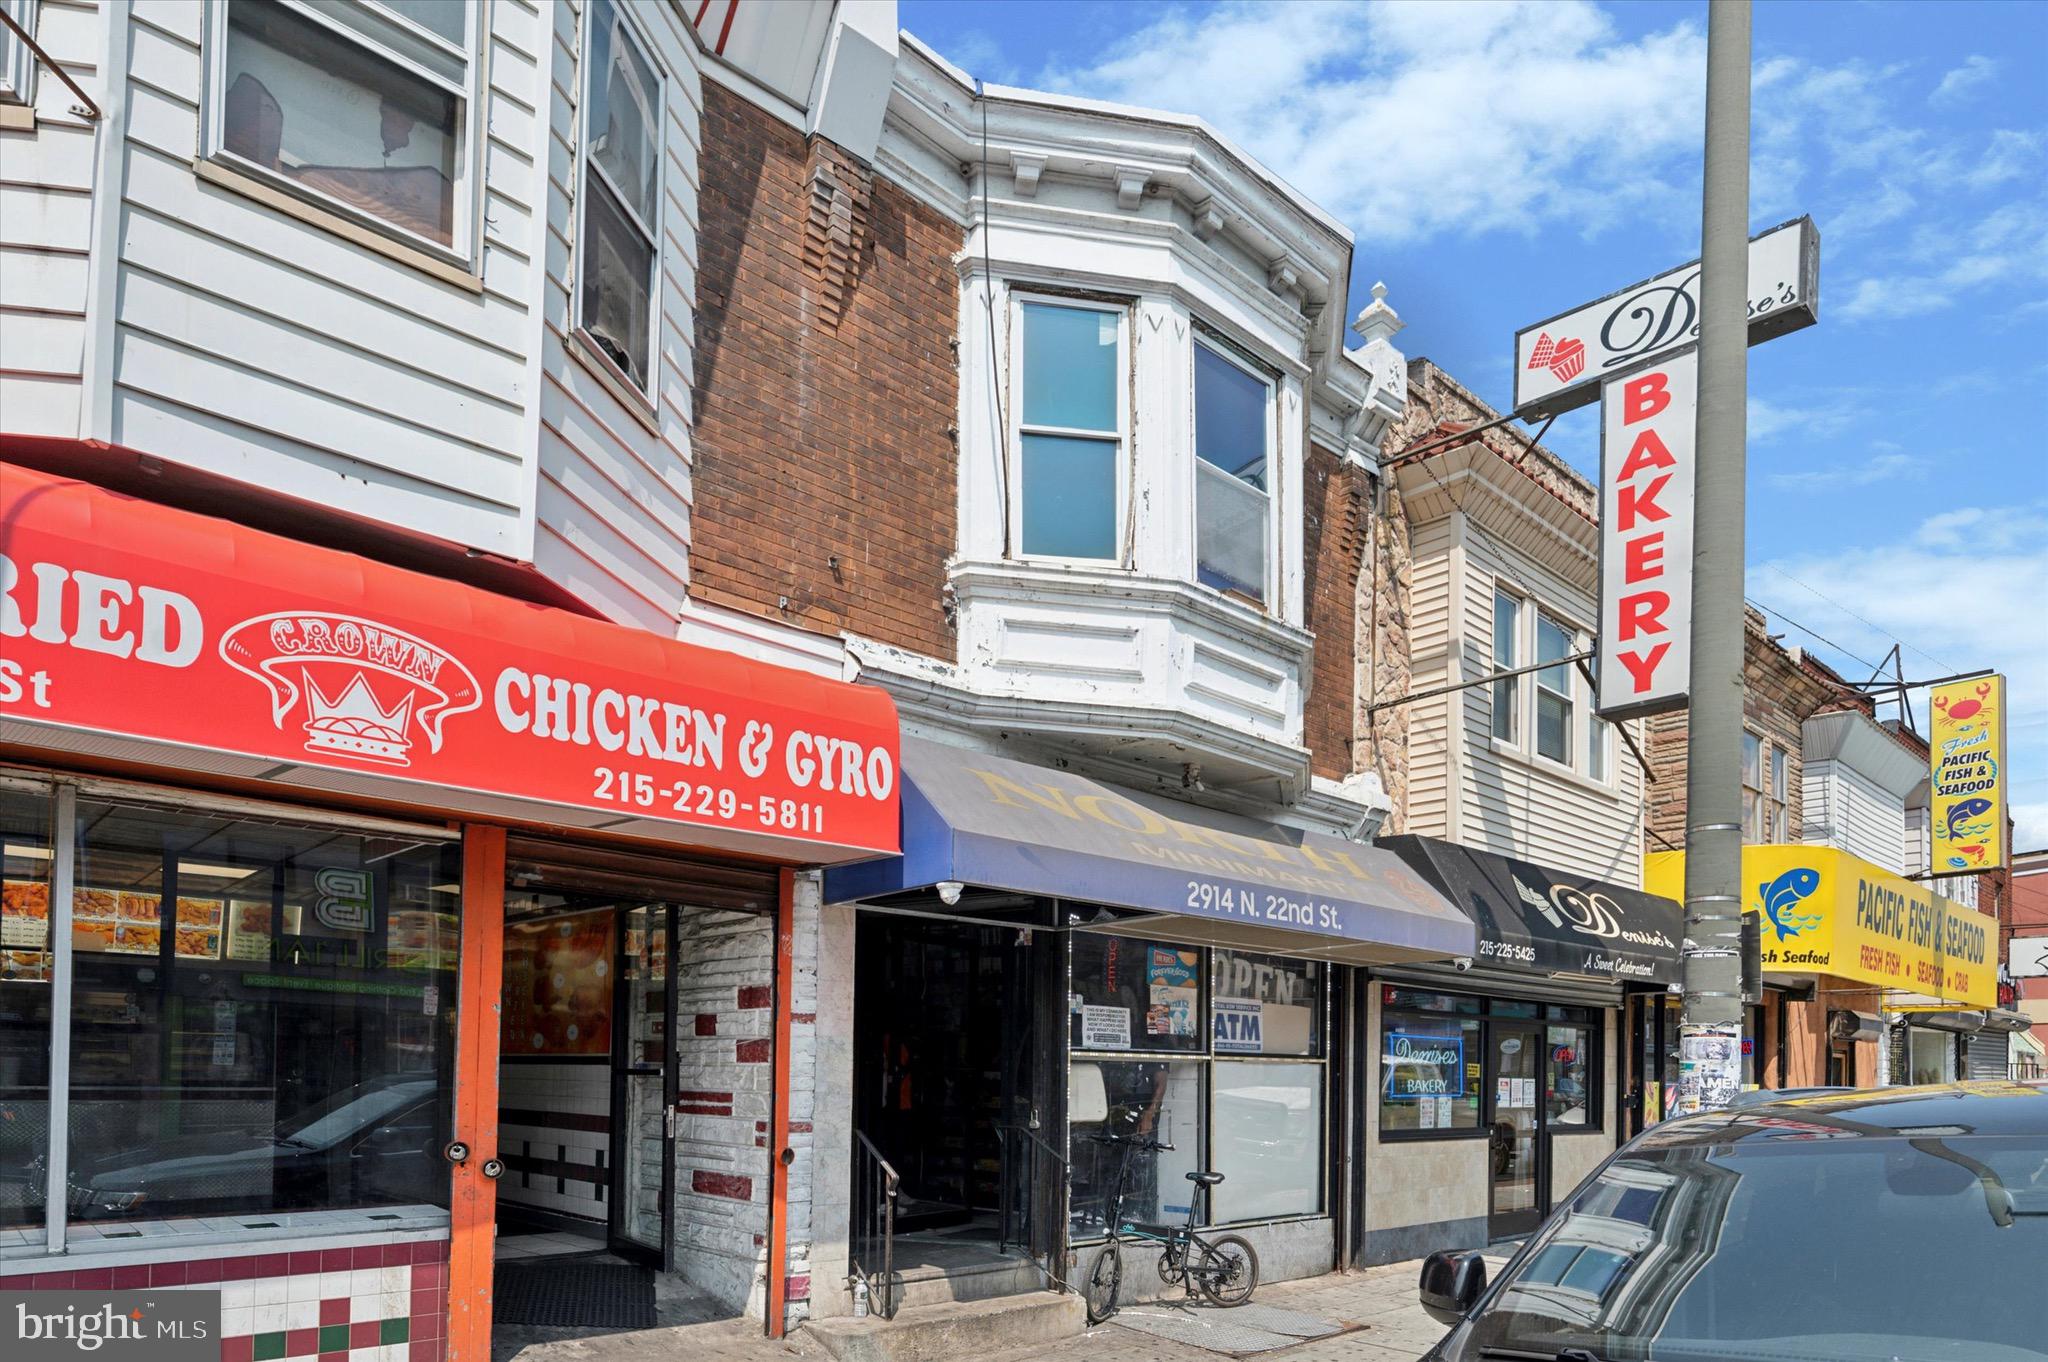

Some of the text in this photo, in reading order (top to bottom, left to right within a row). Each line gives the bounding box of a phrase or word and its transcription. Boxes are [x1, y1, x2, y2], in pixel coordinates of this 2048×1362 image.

[1601, 271, 1796, 368] Dese's
[1616, 372, 1677, 694] BAKERY
[270, 618, 447, 684] CROWN
[0, 658, 52, 708] St
[494, 667, 893, 800] CHICKEN & GYRO
[1942, 729, 1988, 756] Fresh
[1942, 750, 1990, 767] PACIFIC
[1944, 765, 1987, 781] FISH &
[593, 767, 823, 833] 215-229-5811
[1937, 778, 1995, 797] SEAFOOD
[1187, 881, 1342, 930] 2914 N. 22nd St.
[1856, 877, 1985, 965] PACIFIC FISH & SEAFOOD
[1107, 940, 1118, 992] OPEN
[1480, 939, 1536, 961] 215-225-5425
[1584, 953, 1655, 977] A Sweet Celebration!
[1782, 950, 1830, 965] Seafood
[1860, 944, 1881, 976] FRESH
[1884, 949, 1901, 978] FISH
[1916, 958, 1944, 987] SEAFOOD
[1954, 970, 1969, 993] CRAB
[1214, 953, 1296, 1005] OPEN
[1214, 1013, 1260, 1041] ATM
[1407, 1079, 1447, 1093] BAKERY
